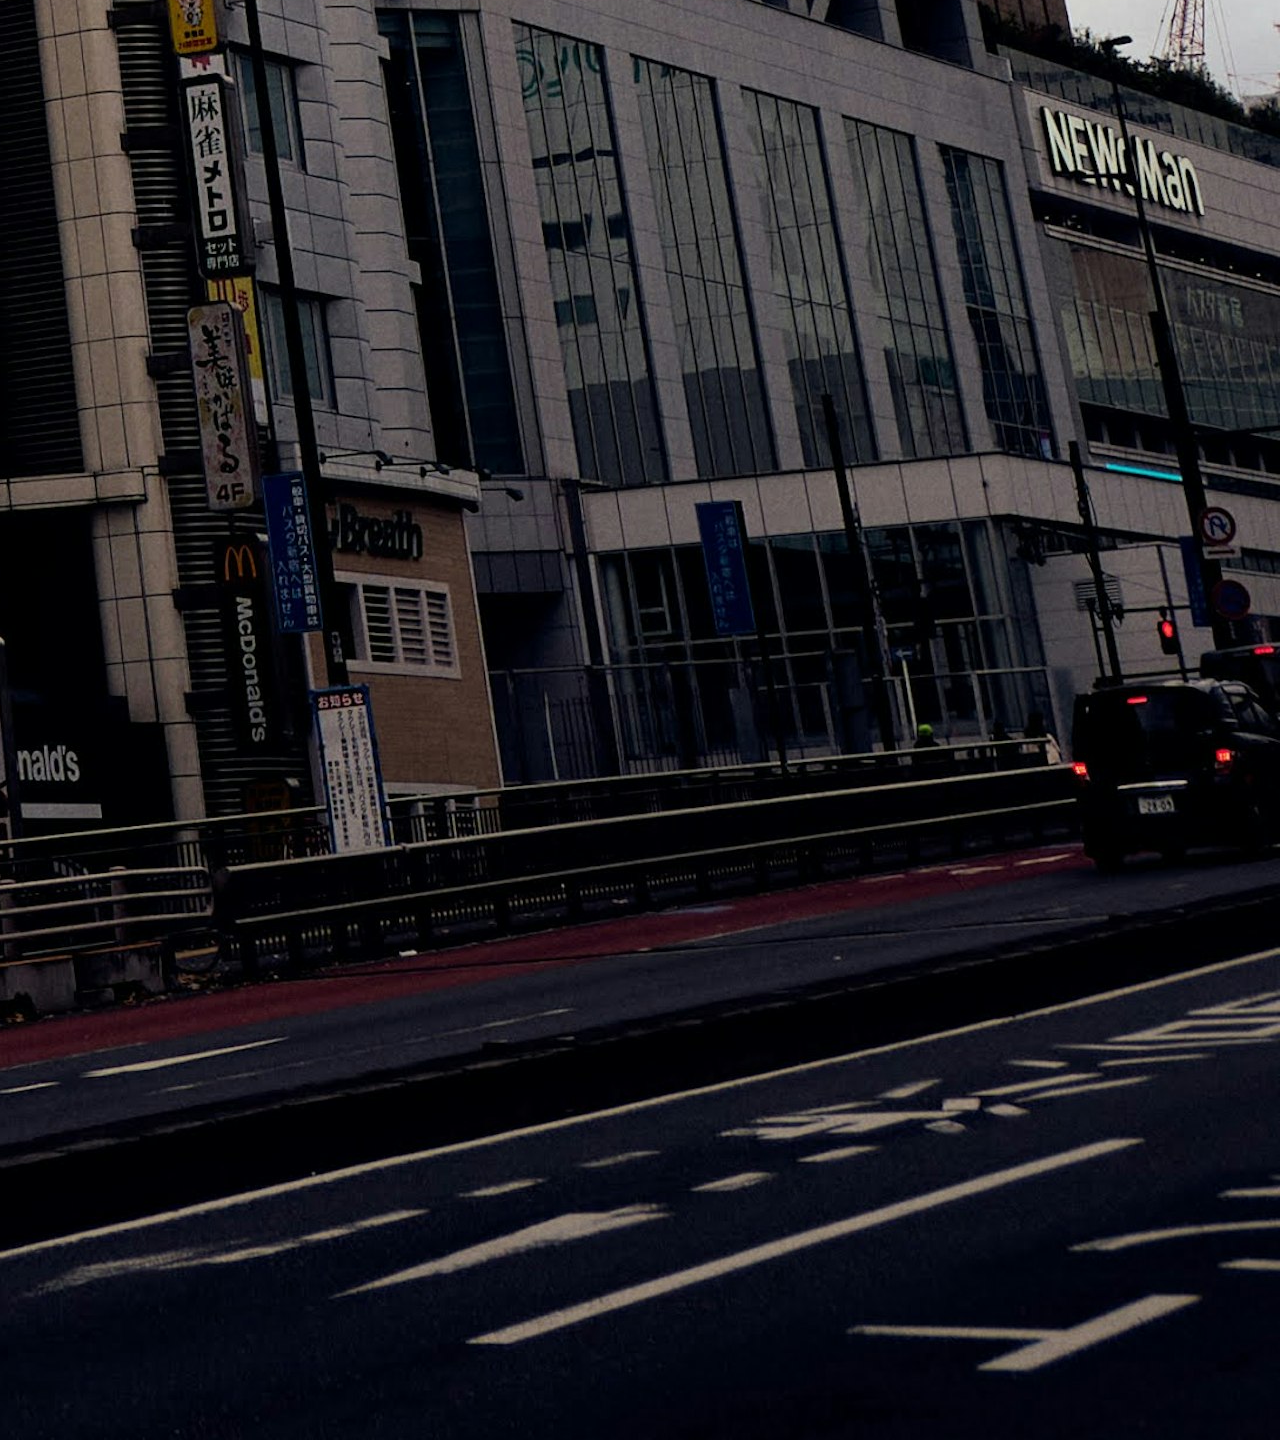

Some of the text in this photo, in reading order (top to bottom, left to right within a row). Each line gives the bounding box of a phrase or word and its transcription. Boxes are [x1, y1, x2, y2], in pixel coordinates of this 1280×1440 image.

[191, 88, 229, 234] 麻雀メトロ
[204, 237, 238, 256] セット
[216, 482, 246, 503] 4F
[234, 594, 266, 744] McDonald's
[317, 692, 366, 710] お知らせ
[16, 743, 81, 783] nald's
